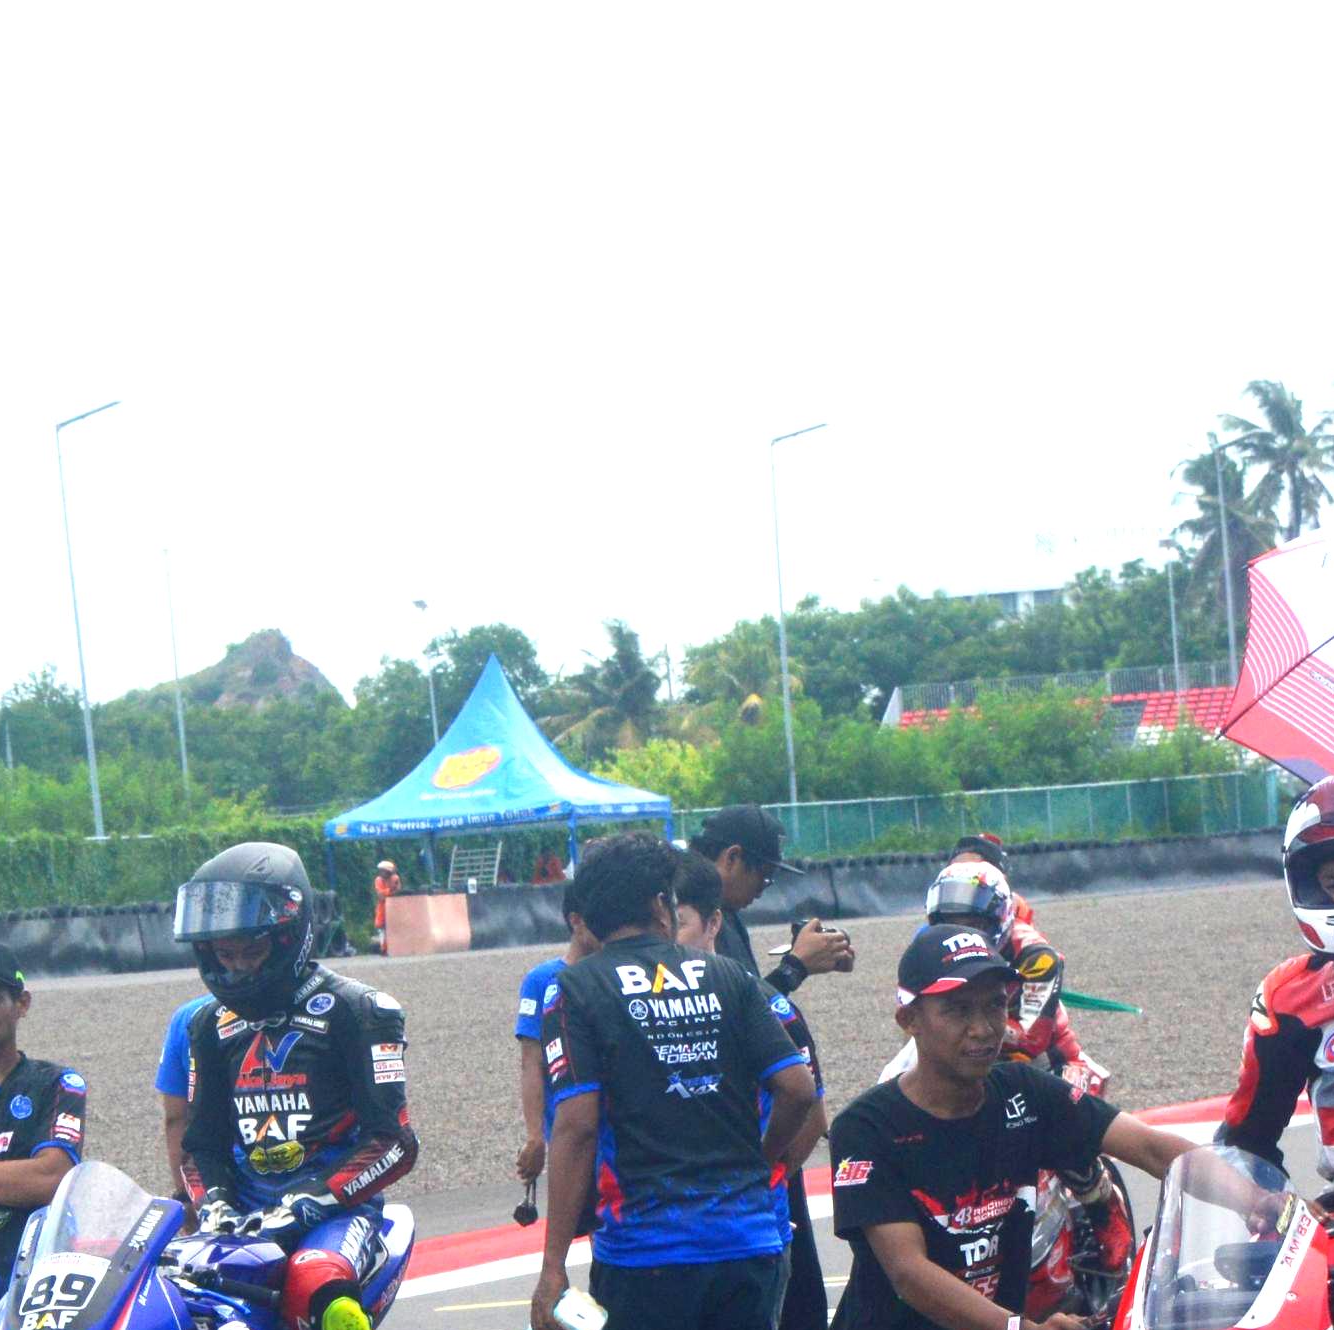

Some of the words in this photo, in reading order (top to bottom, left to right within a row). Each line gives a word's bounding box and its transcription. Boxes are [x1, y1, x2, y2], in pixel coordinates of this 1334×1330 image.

[616, 960, 707, 996] BAF
[647, 992, 722, 1019] YAMAHA
[234, 1092, 311, 1115] YAMAHA
[238, 1114, 314, 1145] BAF
[342, 1143, 405, 1198] YAMALUBE
[954, 1206, 972, 1223] 43
[21, 1273, 97, 1313] 89
